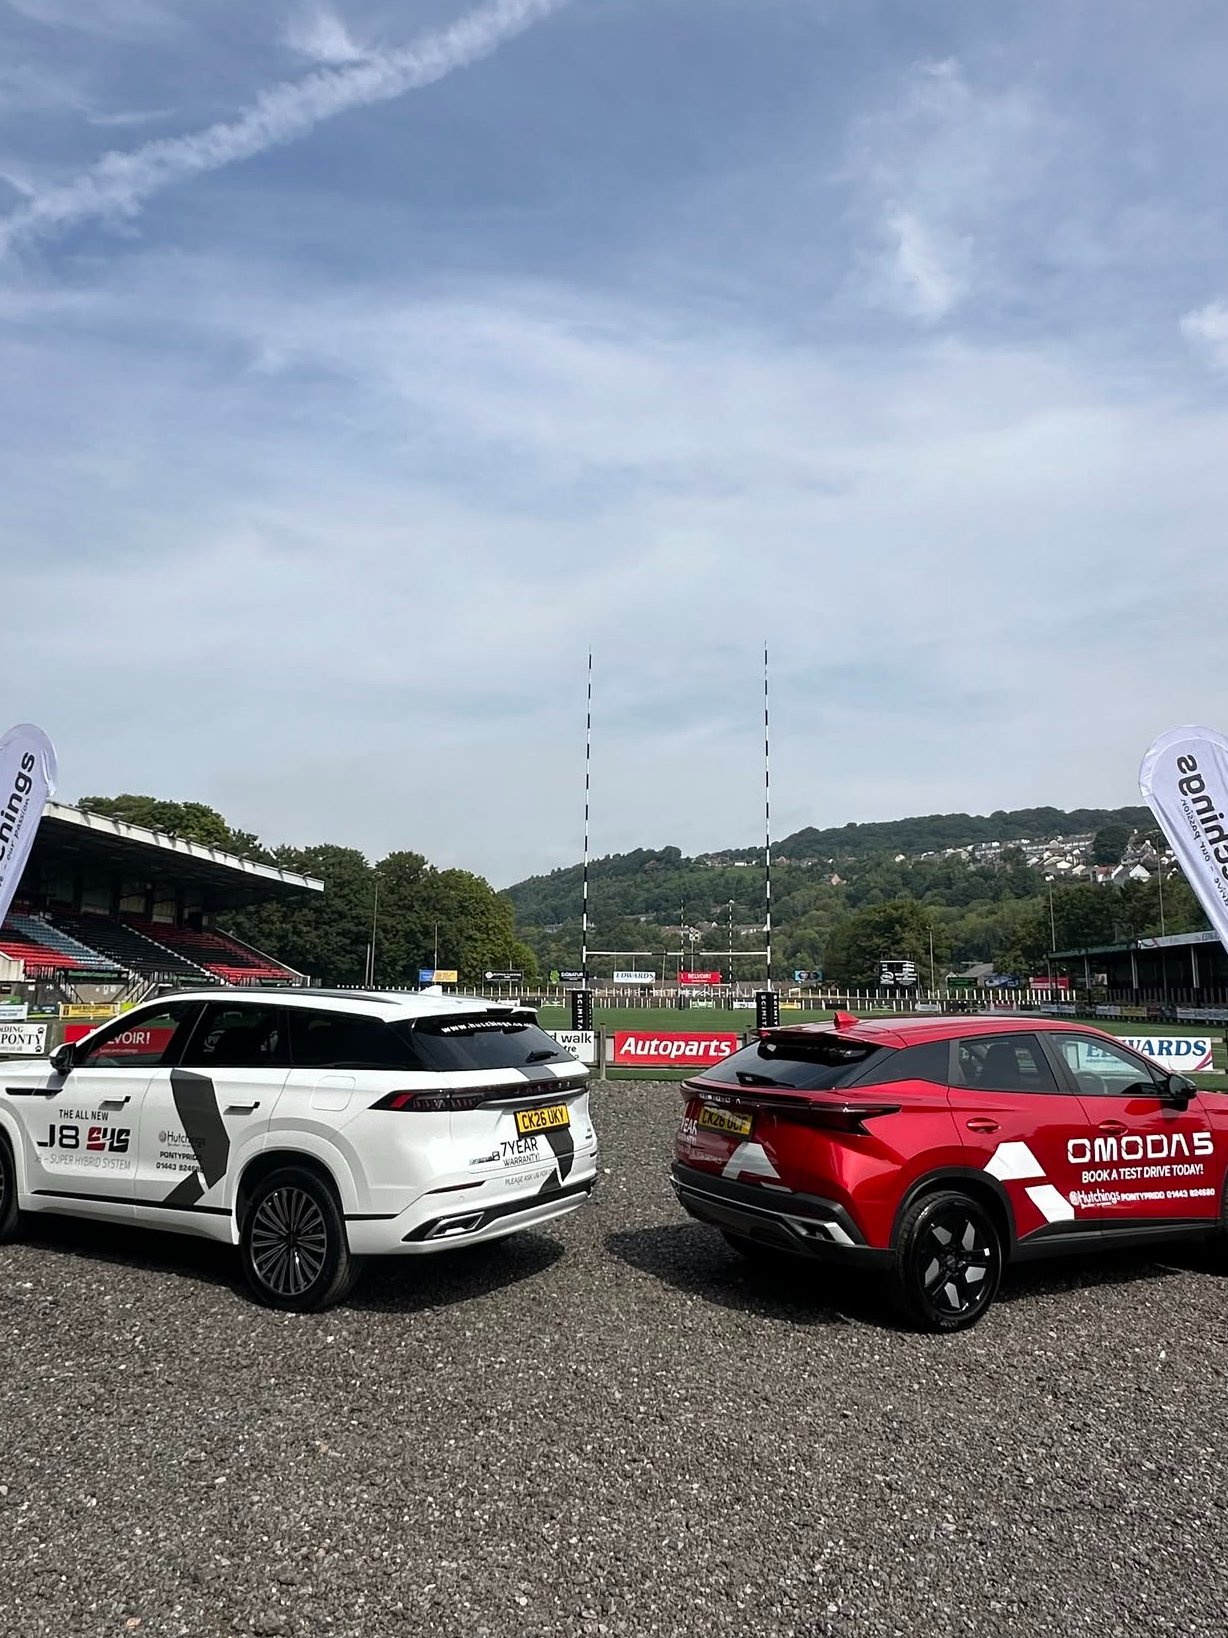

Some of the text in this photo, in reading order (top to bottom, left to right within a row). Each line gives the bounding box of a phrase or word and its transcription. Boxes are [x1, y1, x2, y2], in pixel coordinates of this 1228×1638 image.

[1, 1033, 43, 1045] PONTY
[561, 1032, 592, 1043] walk
[620, 1037, 732, 1058] Autoparts
[59, 1109, 109, 1121] THE ALL NEW
[521, 1107, 564, 1130] CK26 UKY
[1081, 1169, 1111, 1183] BOOK
[1119, 1166, 1143, 1180] TEST
[1143, 1165, 1171, 1178] DRIVE
[1171, 1163, 1204, 1176] TODAY!
